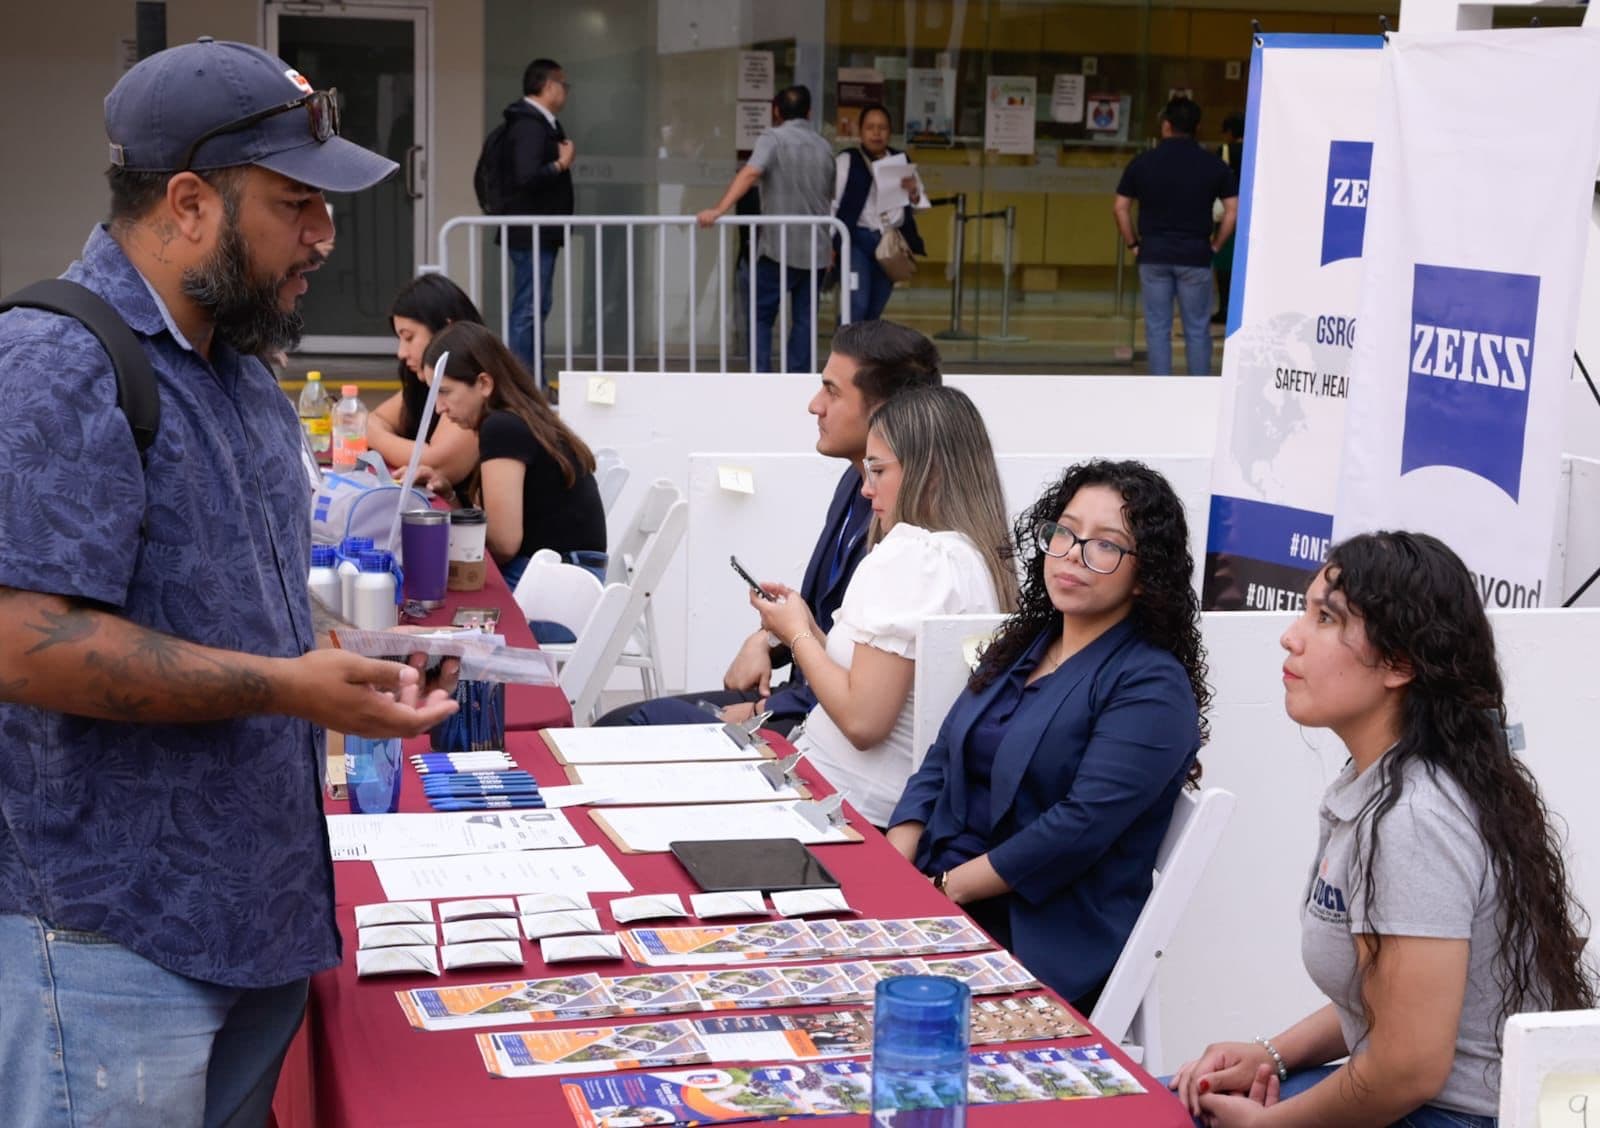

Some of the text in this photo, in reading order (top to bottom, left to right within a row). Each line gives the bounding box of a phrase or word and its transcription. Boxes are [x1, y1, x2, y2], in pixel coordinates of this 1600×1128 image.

[1331, 177, 1369, 208] ZE
[1411, 323, 1531, 392] ZEISS
[1275, 367, 1319, 397] SAFETY,
[1290, 532, 1330, 563] #ONE
